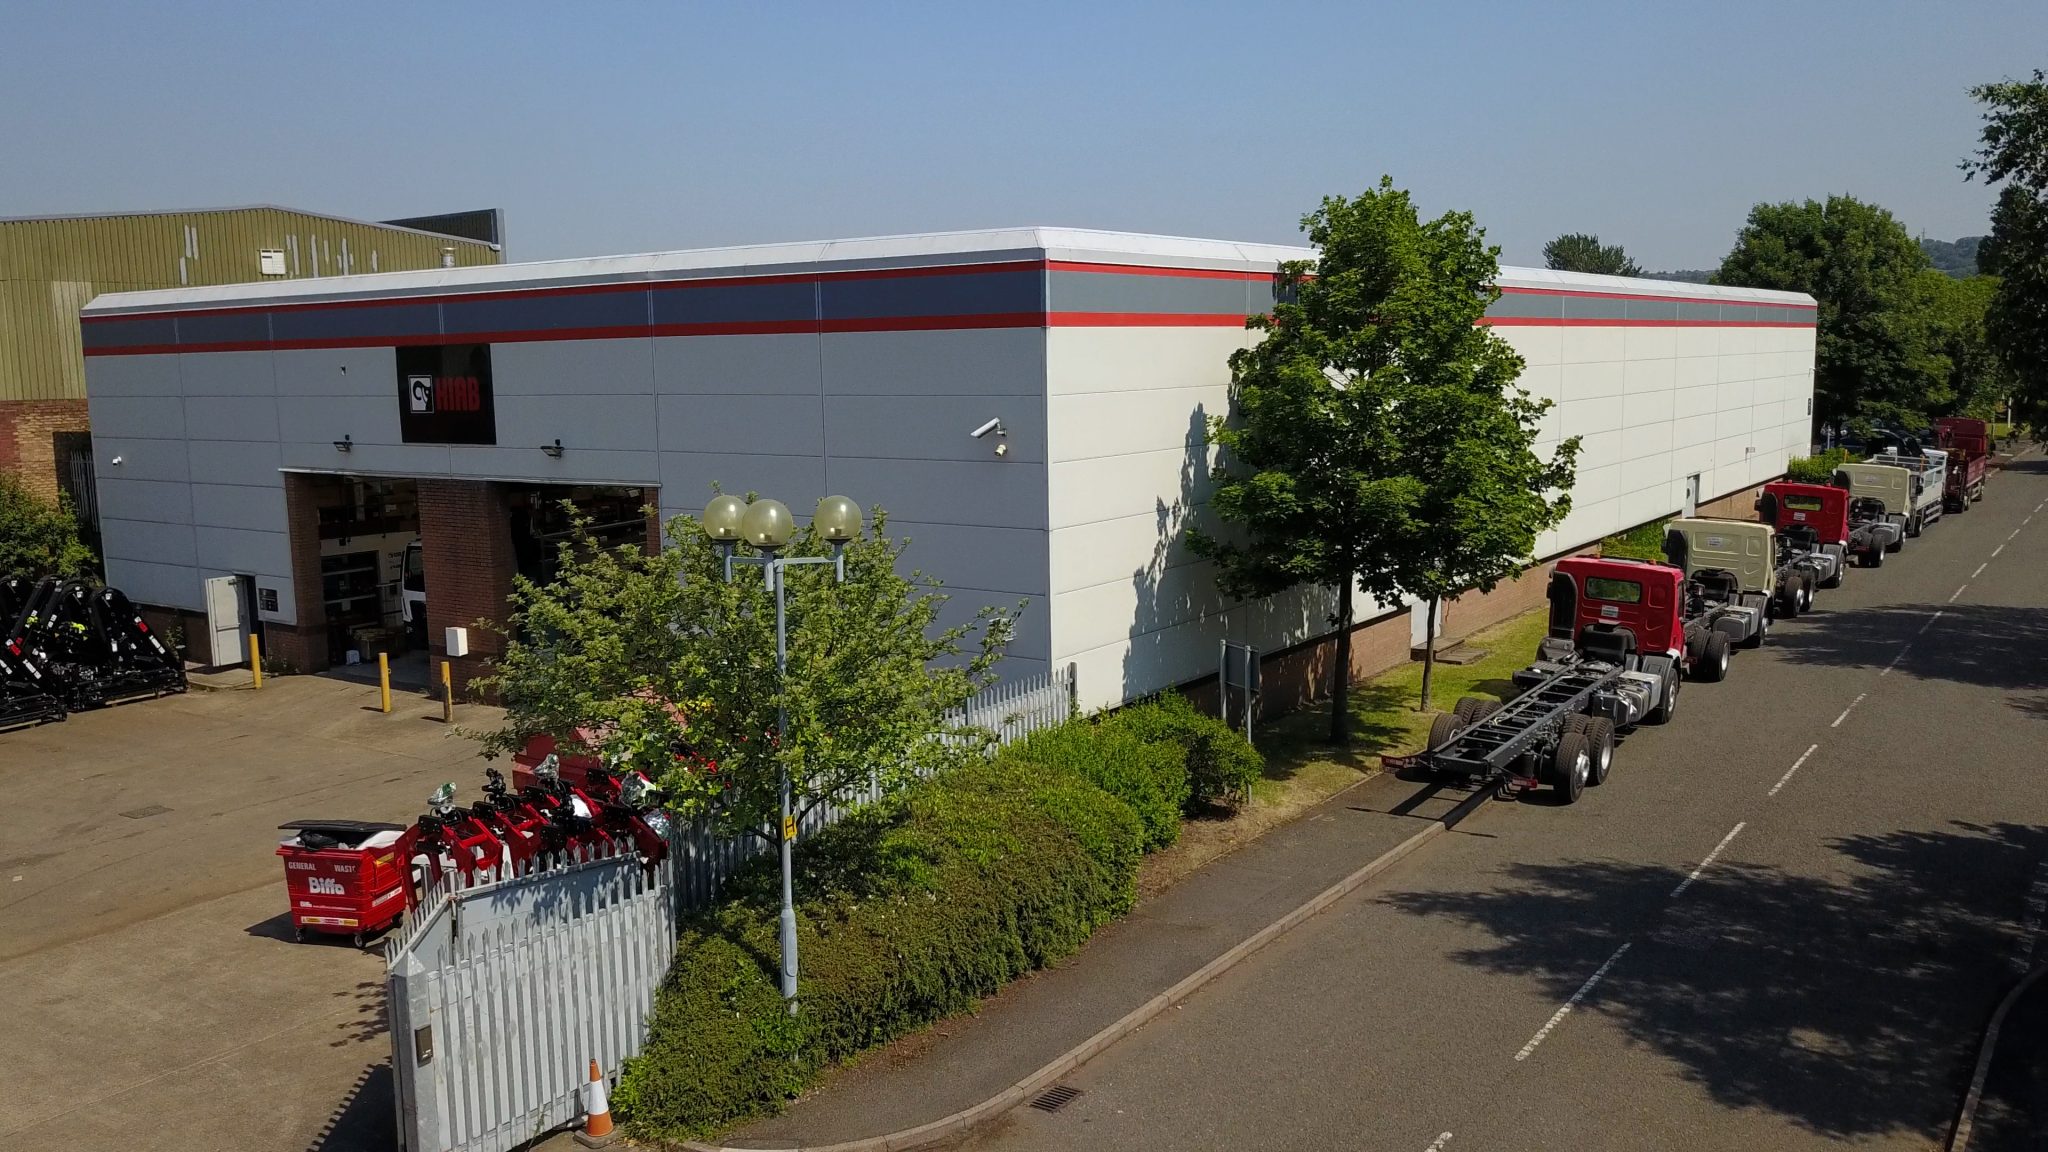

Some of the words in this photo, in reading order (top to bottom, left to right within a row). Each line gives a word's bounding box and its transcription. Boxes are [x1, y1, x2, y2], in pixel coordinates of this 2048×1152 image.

[435, 376, 480, 410] HIAB
[785, 819, 795, 836] H
[288, 861, 317, 871] GENERAL
[308, 876, 345, 895] Biffa
